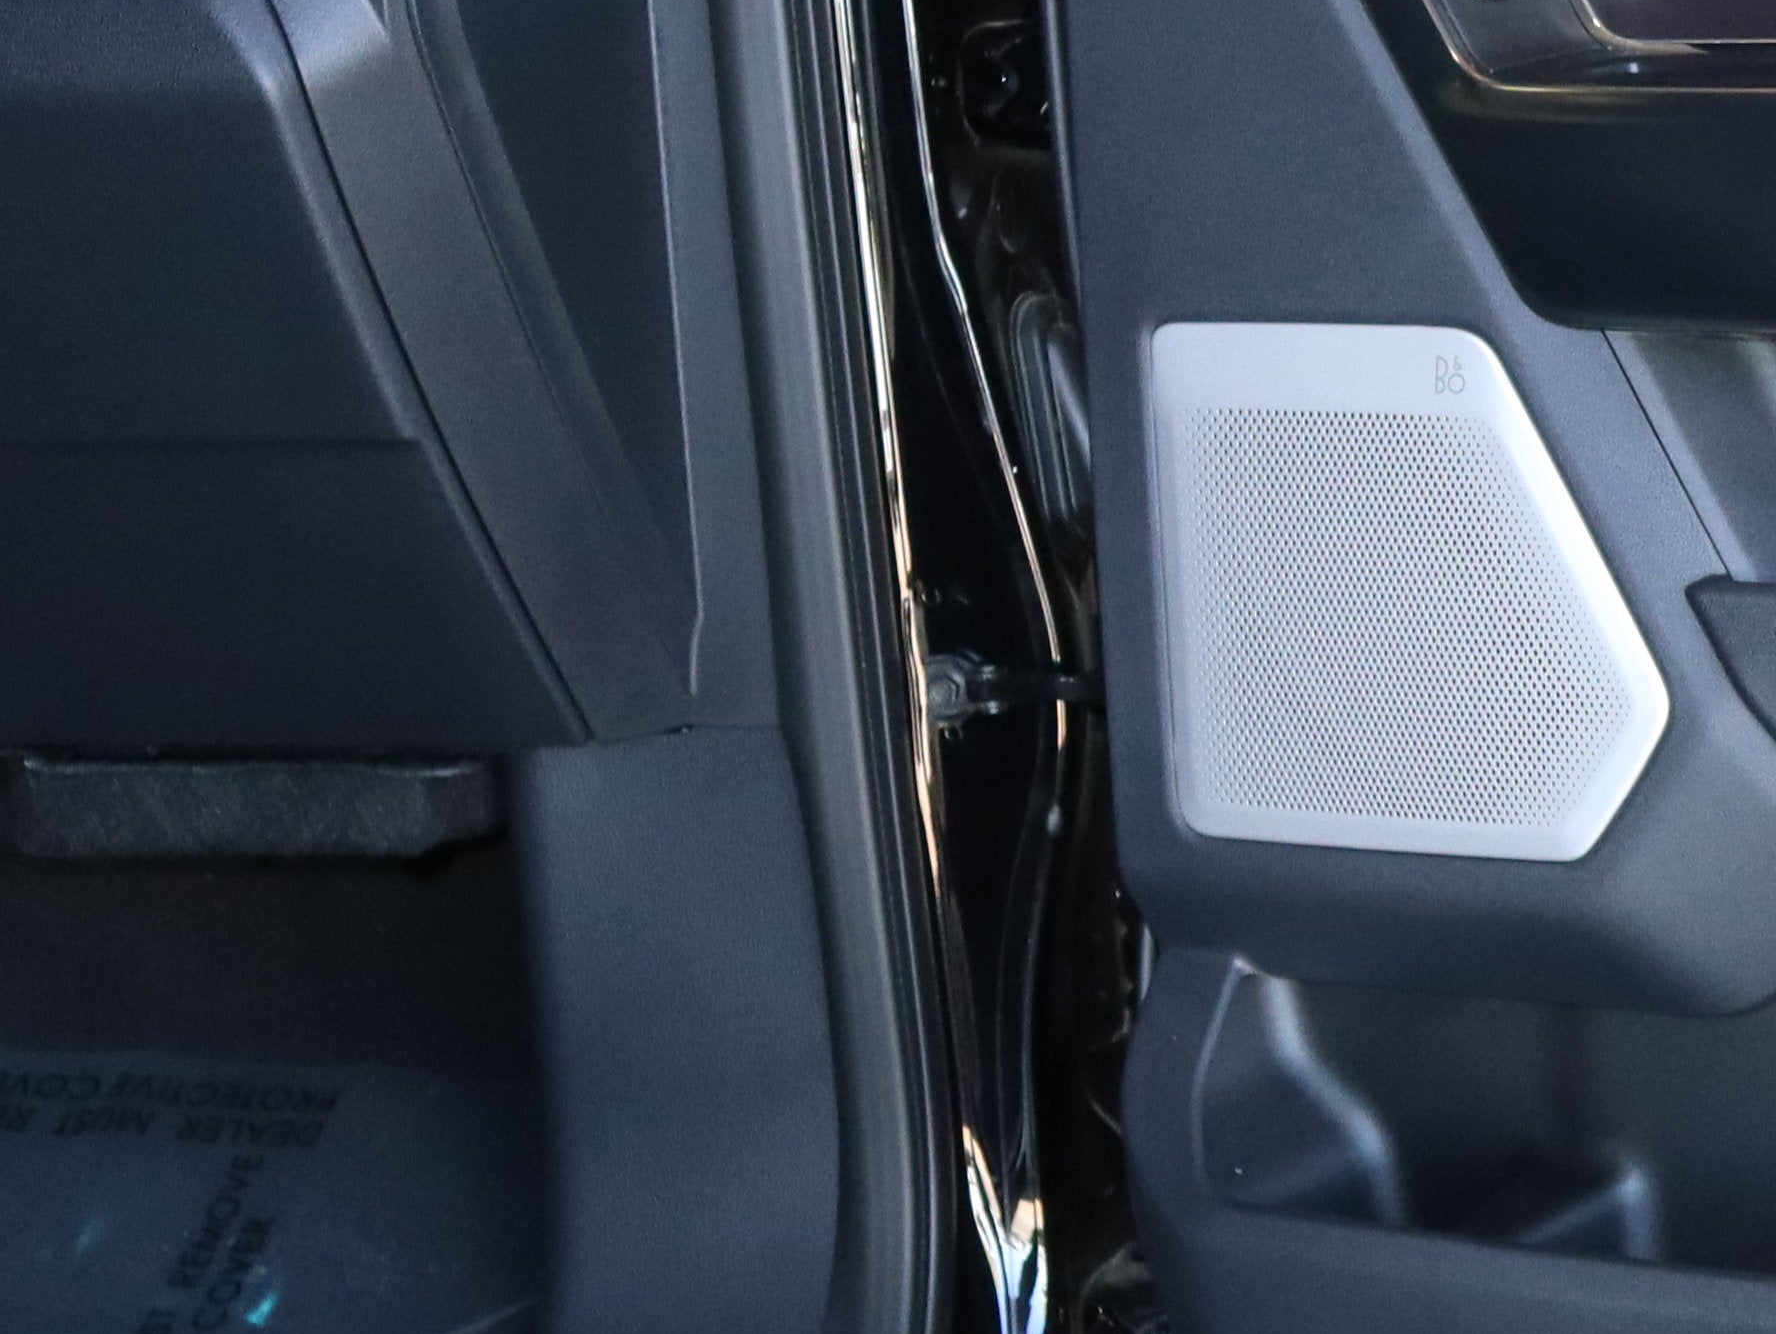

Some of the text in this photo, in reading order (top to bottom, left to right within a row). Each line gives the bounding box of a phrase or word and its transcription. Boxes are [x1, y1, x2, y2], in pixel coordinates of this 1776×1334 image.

[111, 1071, 342, 1113] PROTECTIVE
[52, 1108, 156, 1136] MUST
[176, 1114, 324, 1148] DEALER
[166, 1154, 266, 1289] REMOVE
[191, 1214, 276, 1332] COVER
